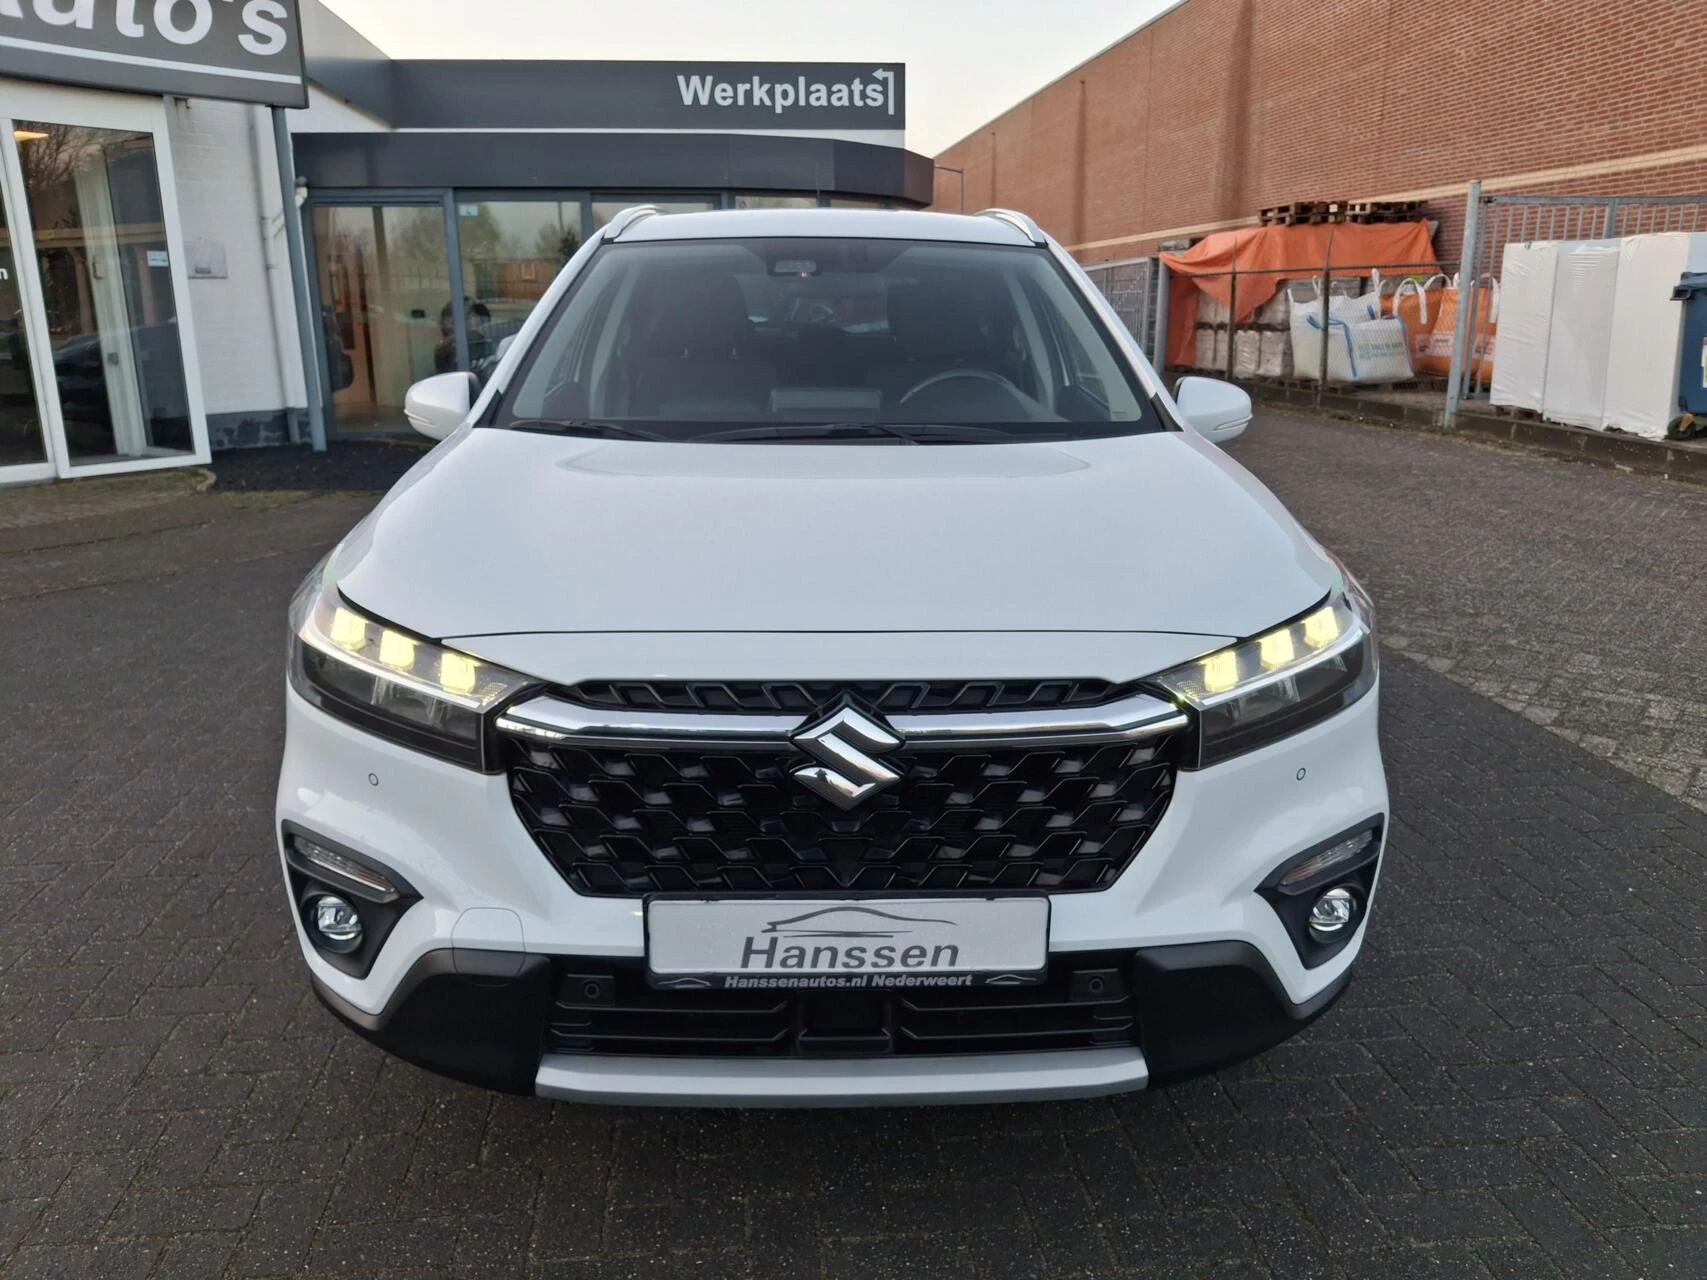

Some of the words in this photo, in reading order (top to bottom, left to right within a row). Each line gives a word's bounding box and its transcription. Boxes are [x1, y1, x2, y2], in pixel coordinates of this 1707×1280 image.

[677, 75, 884, 114] Werkplaats
[740, 936, 959, 969] Hanssen
[724, 975, 868, 988] Hanssenautos.nl
[871, 974, 973, 987] Nederweert
